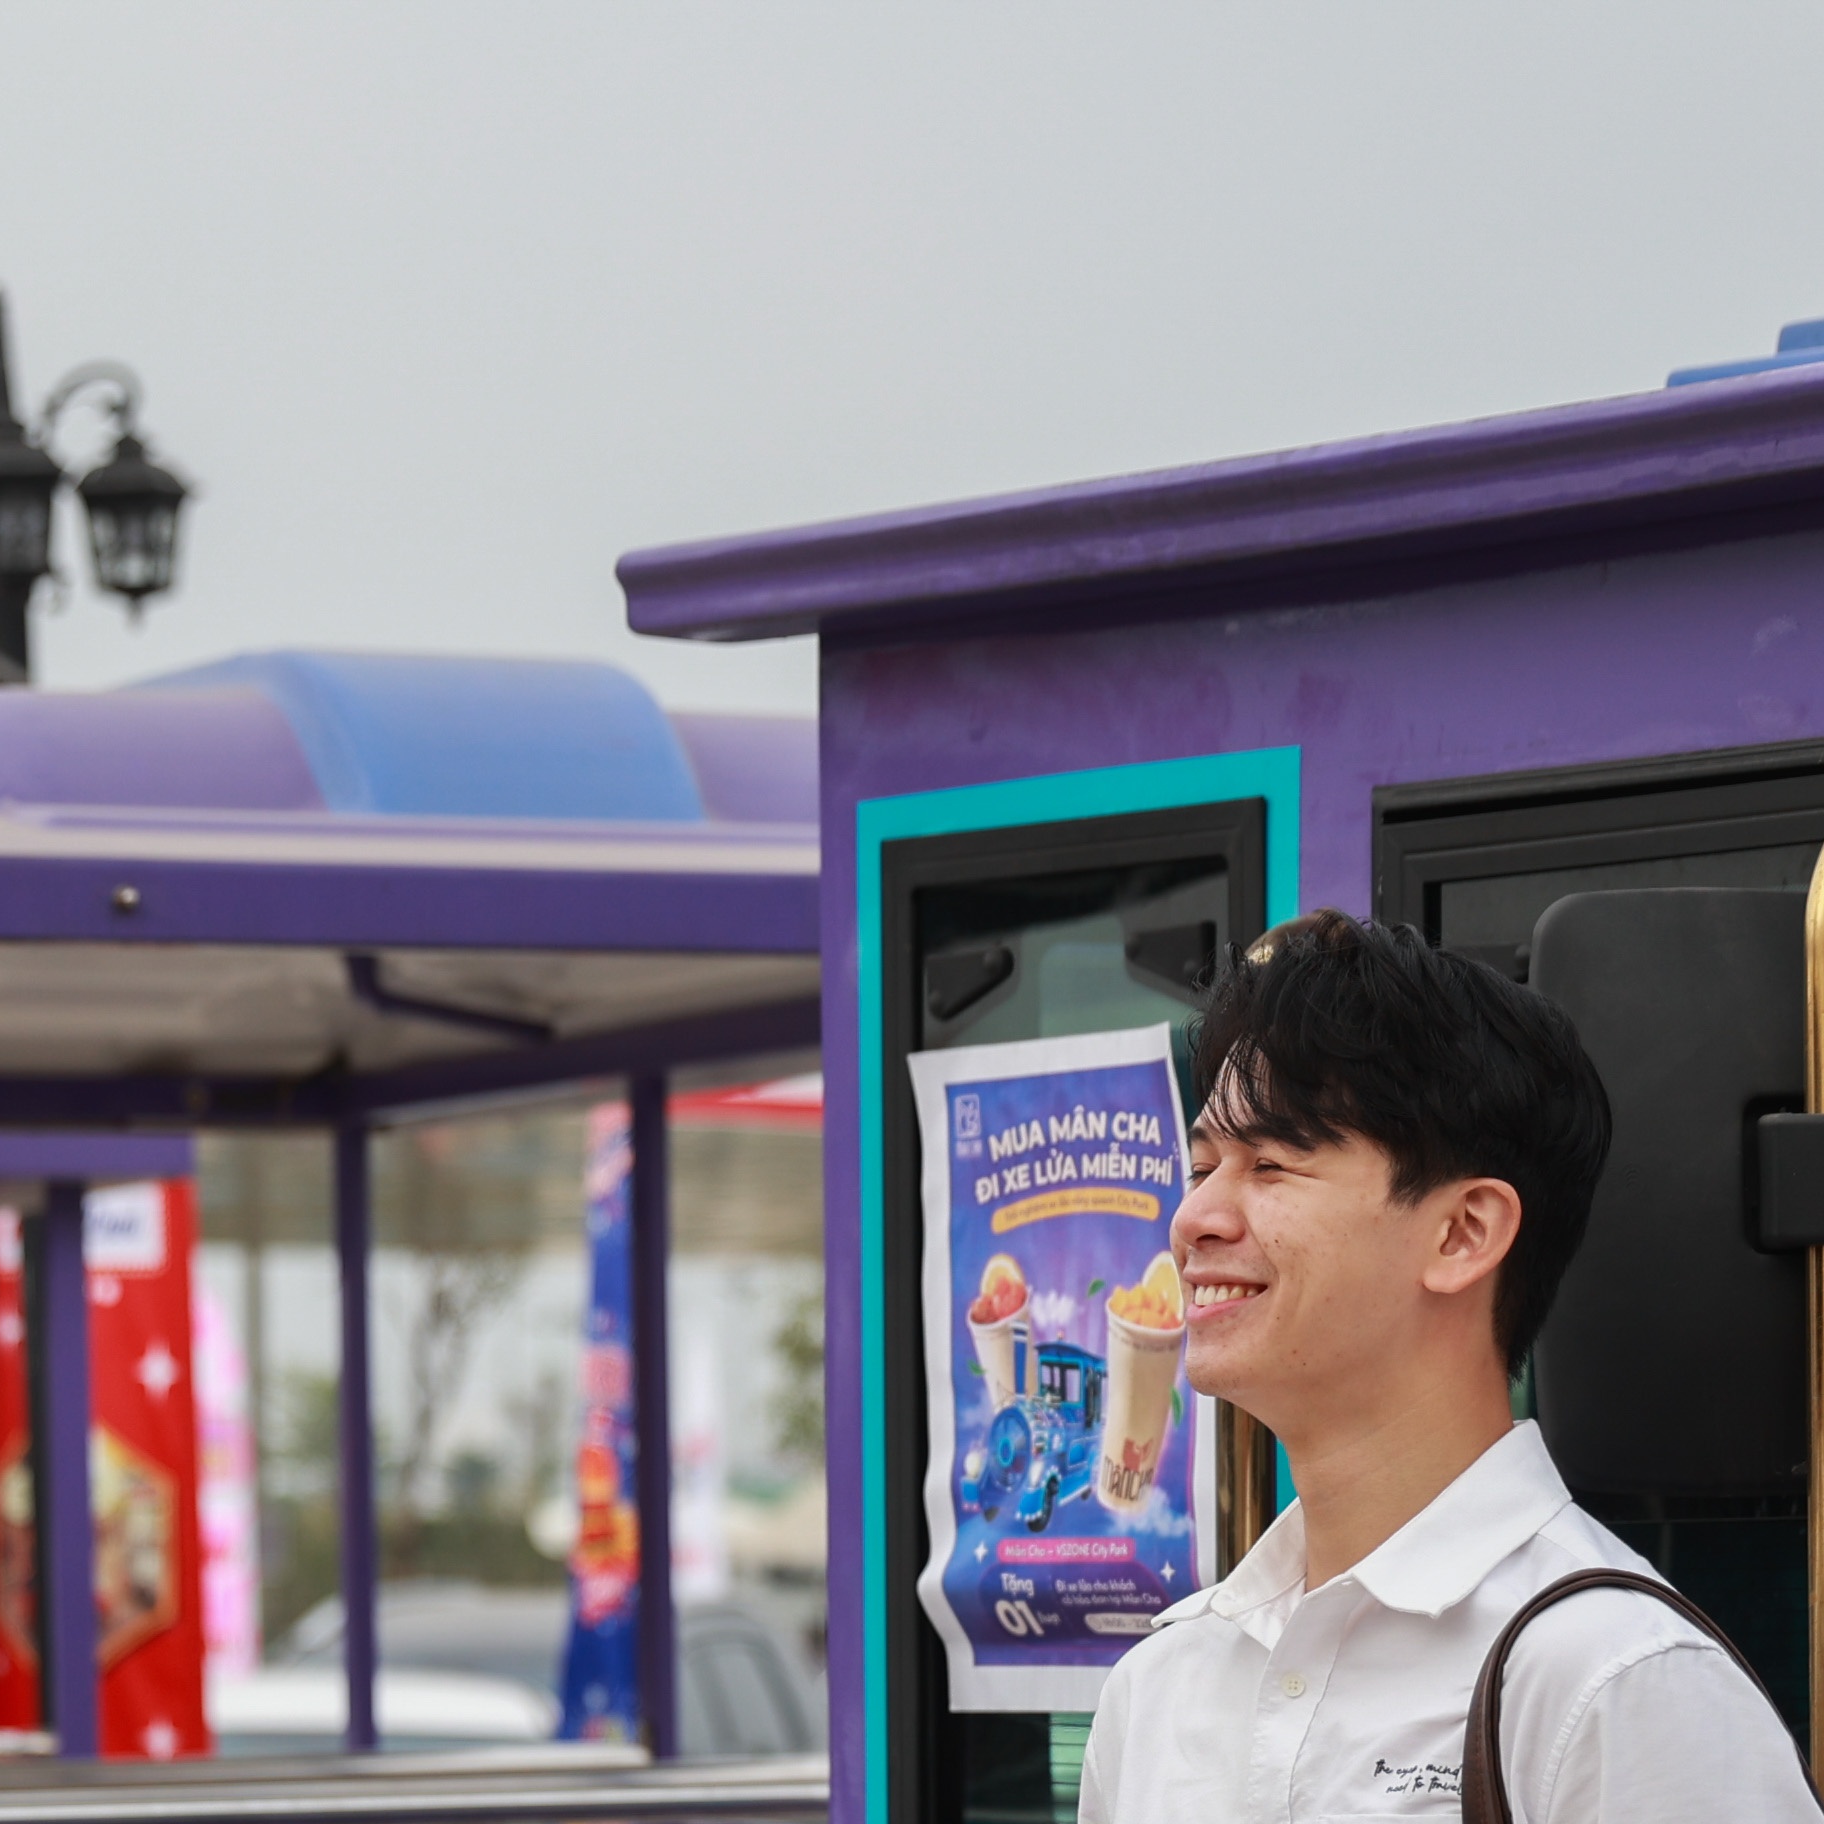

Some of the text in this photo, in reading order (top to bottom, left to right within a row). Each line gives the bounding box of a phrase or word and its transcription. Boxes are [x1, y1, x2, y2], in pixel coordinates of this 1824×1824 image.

[988, 1119, 1046, 1163] MUA
[1049, 1105, 1107, 1145] MÂN
[1112, 1110, 1161, 1146] CHA
[975, 1173, 1000, 1205] ĐI
[1002, 1163, 1031, 1195] XE
[1081, 1142, 1137, 1180] MIỄN
[1141, 1154, 1173, 1187] PHÍ
[1110, 1543, 1128, 1556] Park
[1001, 1573, 1035, 1597] Tặng
[995, 1600, 1044, 1635] 01
